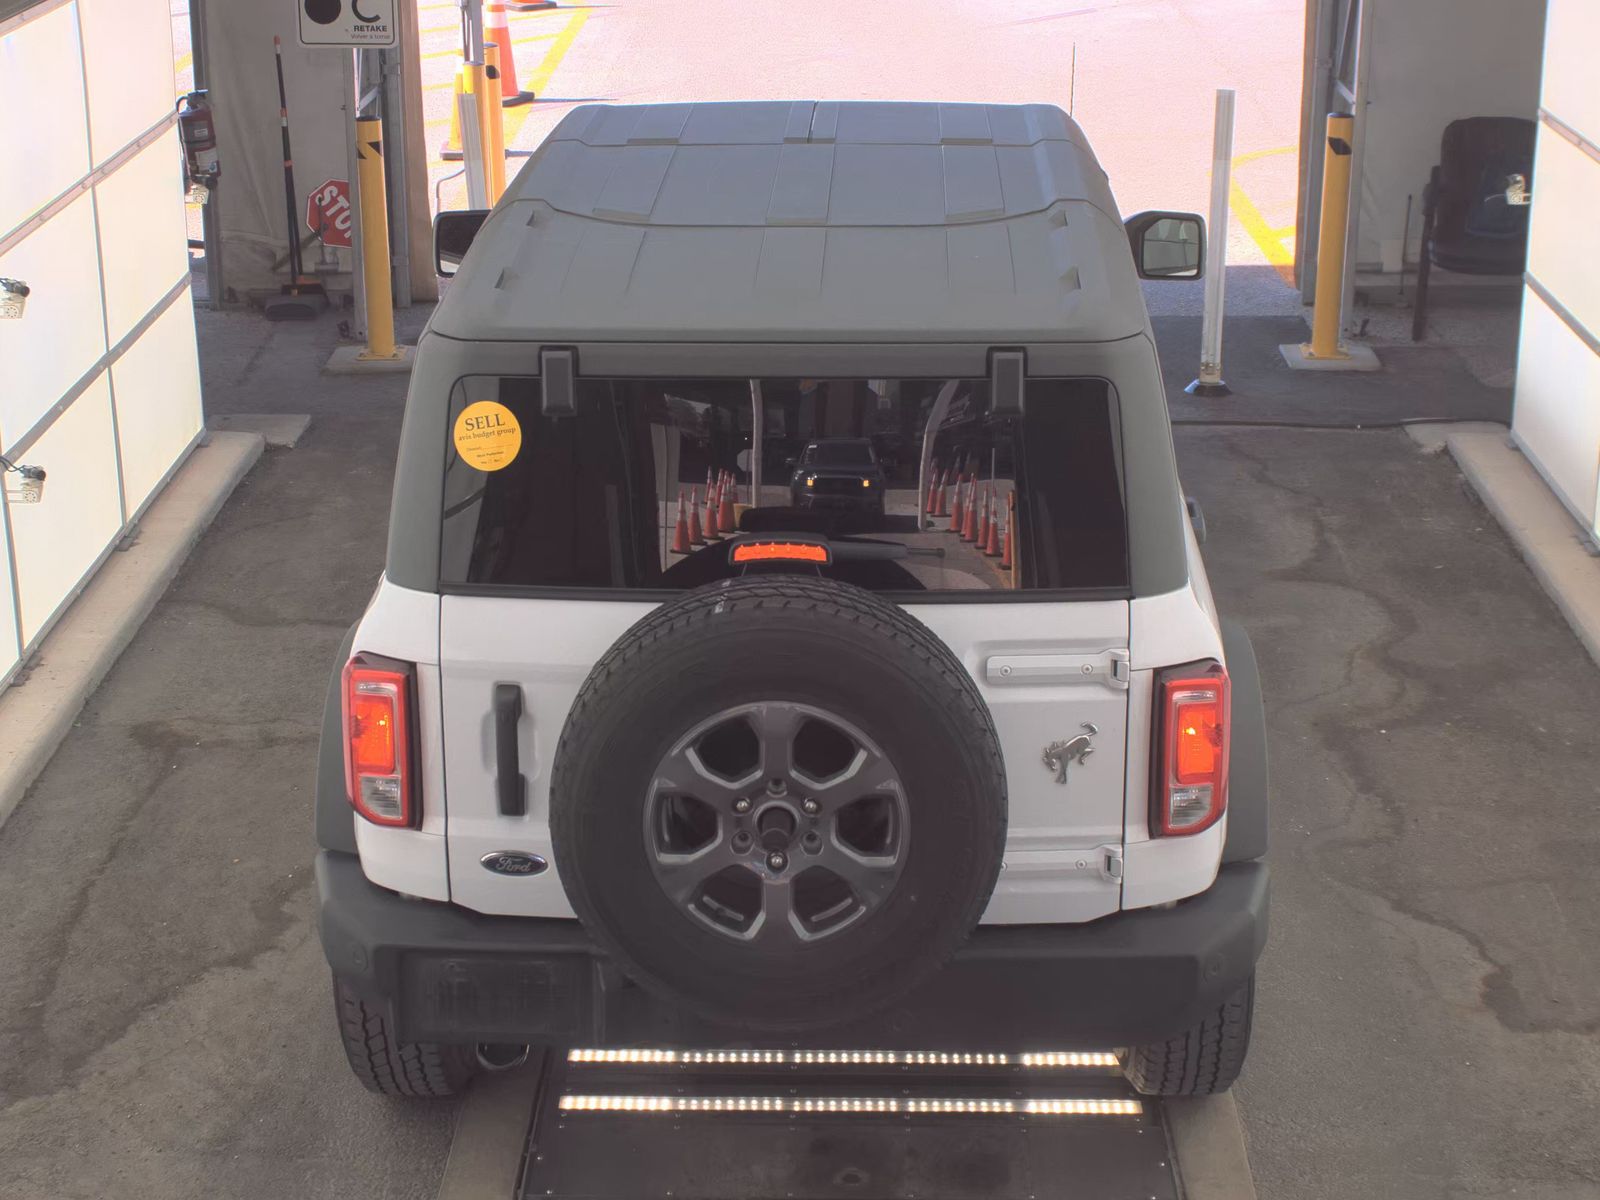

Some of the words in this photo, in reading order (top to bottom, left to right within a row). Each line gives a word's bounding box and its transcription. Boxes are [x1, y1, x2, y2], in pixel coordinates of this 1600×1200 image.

[315, 185, 352, 239] STO
[465, 414, 505, 432] SELL
[496, 428, 516, 436] group
[495, 856, 531, 872] Ford
